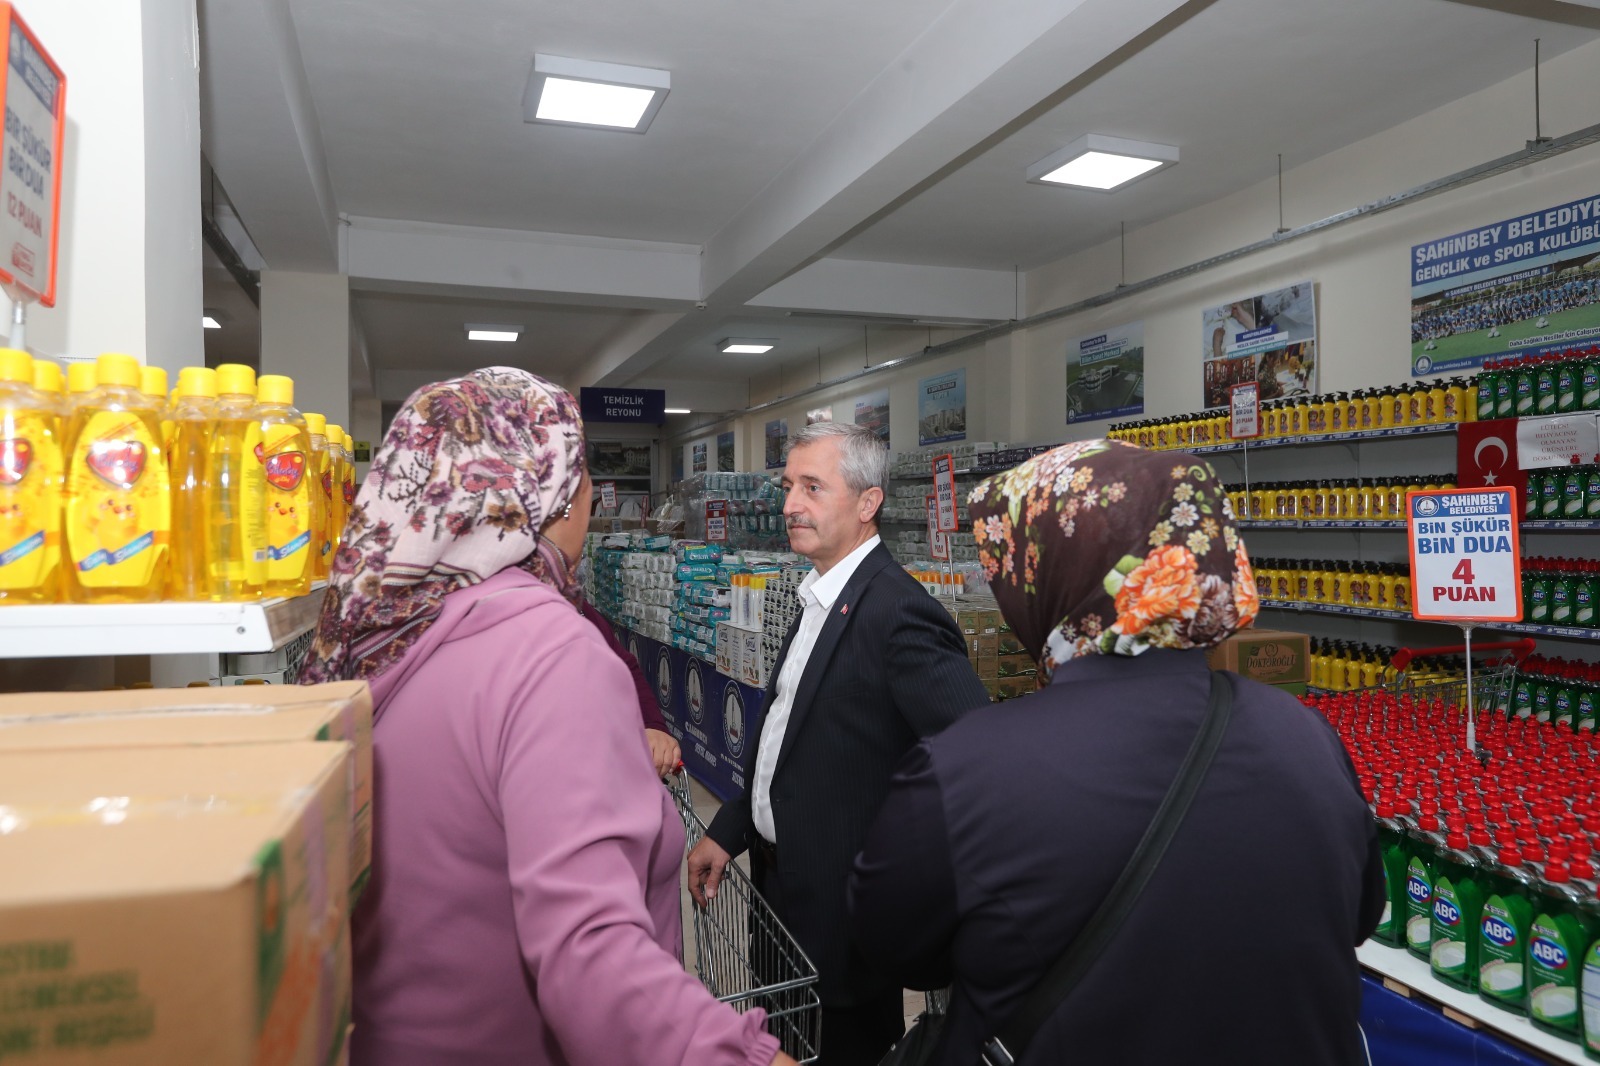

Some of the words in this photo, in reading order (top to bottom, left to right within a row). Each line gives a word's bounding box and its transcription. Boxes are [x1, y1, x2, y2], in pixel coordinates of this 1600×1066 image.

[1474, 254, 1490, 268] ve
[1494, 241, 1533, 263] SPOR
[1539, 381, 1551, 389] ABC
[1559, 379, 1571, 387] ABC
[1584, 376, 1596, 384] ABC
[603, 394, 644, 405] TEMİZLİK
[606, 408, 641, 417] REYONU
[1442, 493, 1505, 509] ŞAHİNBEY
[1449, 505, 1498, 515] BELEDİYESİ
[1451, 517, 1510, 536] ŞÜKÜR
[1463, 535, 1512, 553] DUA
[1452, 558, 1475, 584] 4
[1432, 586, 1496, 602] PUAN
[1536, 696, 1547, 704] ABC
[1557, 700, 1569, 708] ABC
[1408, 881, 1429, 899] ABC
[1434, 902, 1458, 922] ABC
[1484, 920, 1513, 942] ABC
[1533, 942, 1564, 965] ABC
